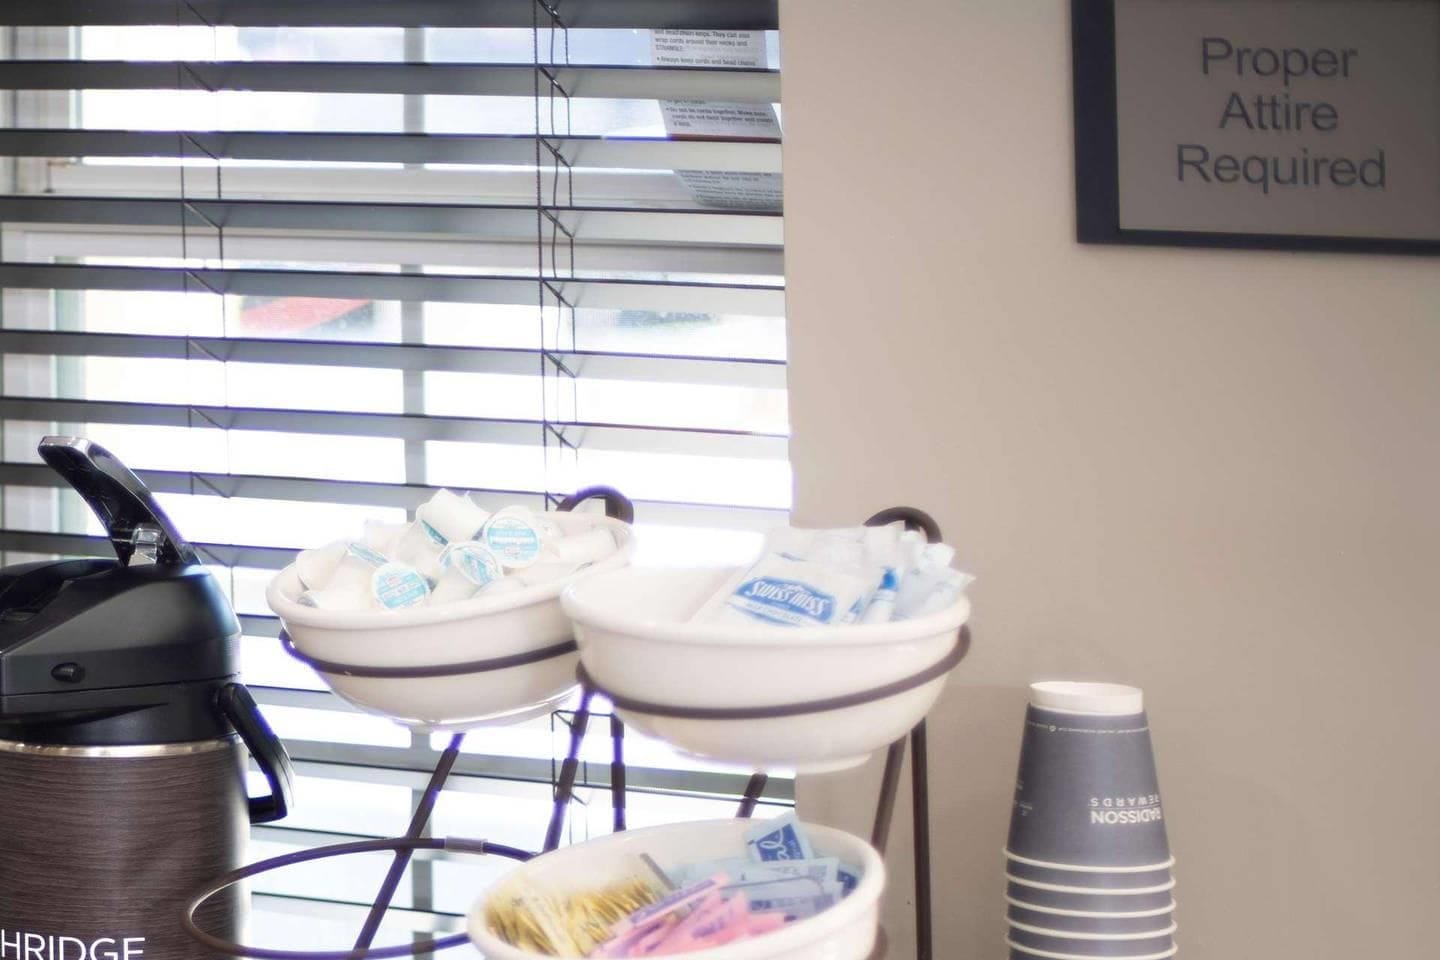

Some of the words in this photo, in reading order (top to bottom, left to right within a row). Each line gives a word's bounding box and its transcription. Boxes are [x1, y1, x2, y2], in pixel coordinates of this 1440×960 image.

[1201, 37, 1358, 86] Proper
[1219, 92, 1338, 131] Attire
[1176, 144, 1386, 194] Required
